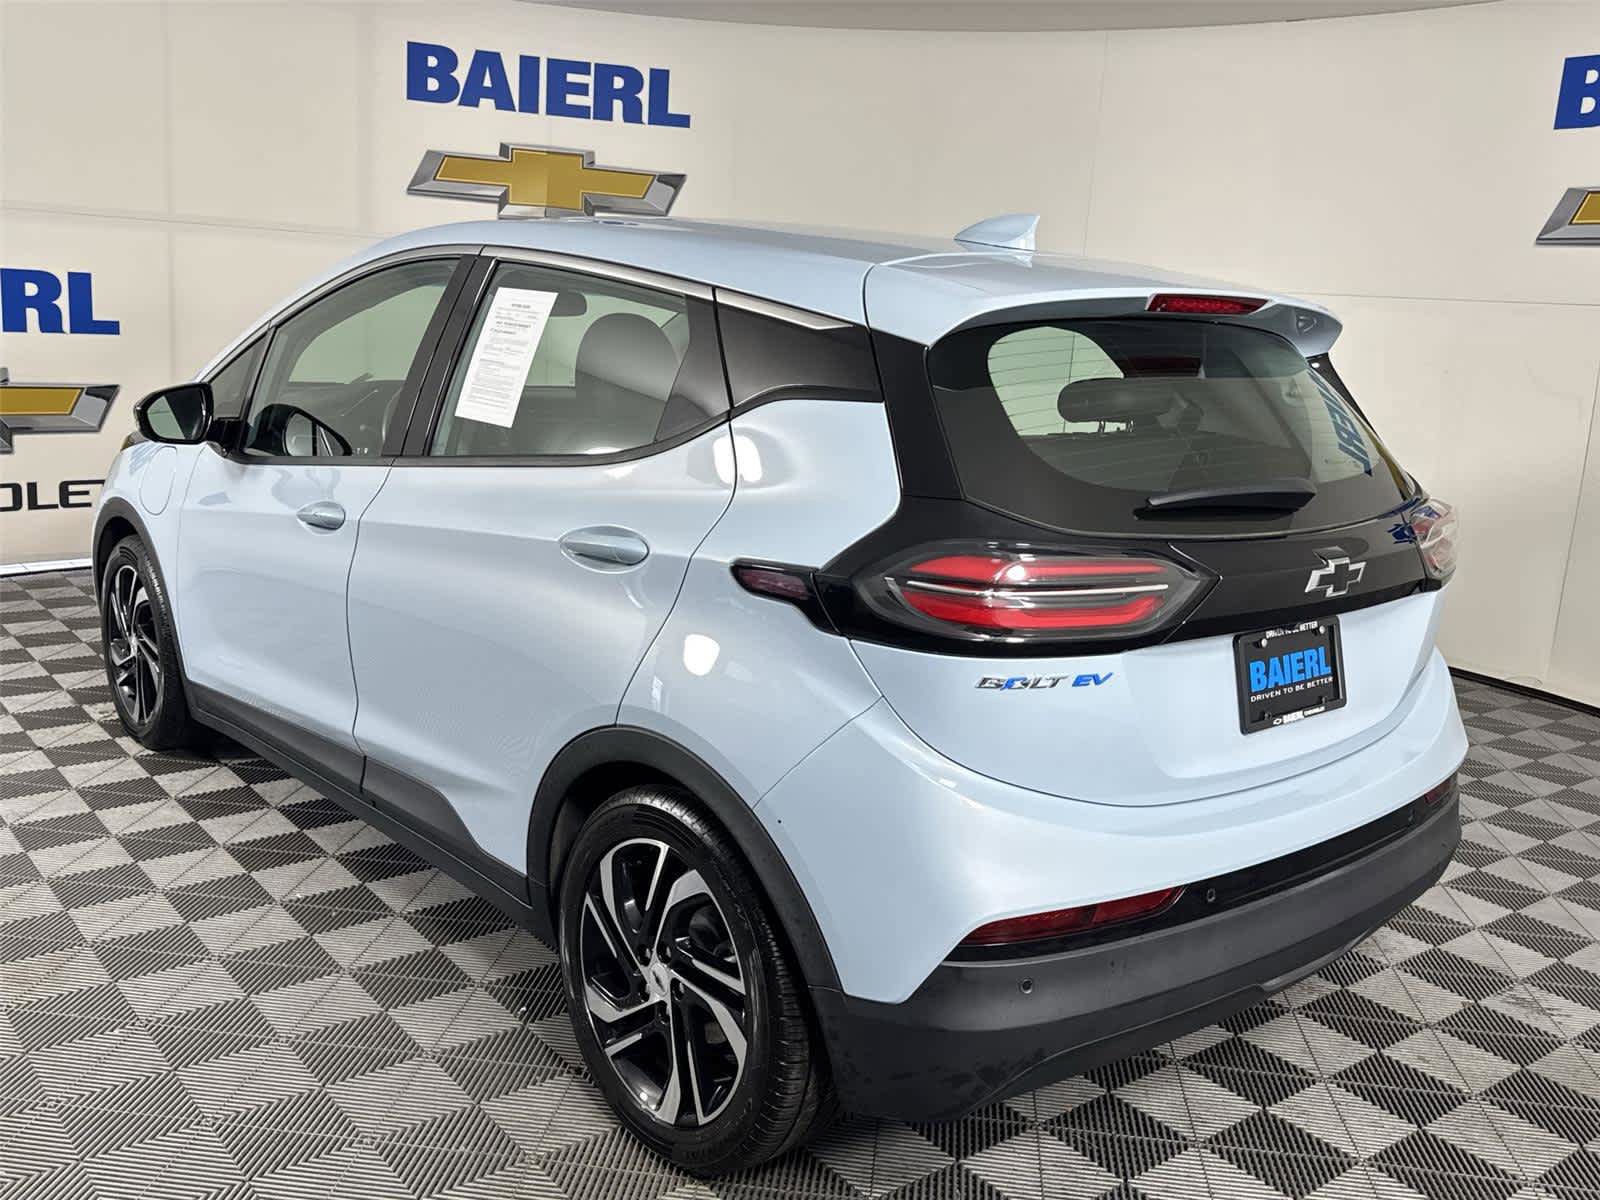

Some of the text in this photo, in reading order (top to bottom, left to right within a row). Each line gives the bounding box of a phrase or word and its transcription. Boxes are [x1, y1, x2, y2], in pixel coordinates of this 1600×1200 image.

[406, 40, 691, 129] BAIERL
[0, 479, 106, 512] OLE
[974, 671, 1114, 691] BOLT EV
[1249, 646, 1332, 693] BAIERL
[1250, 676, 1333, 703] DRIVEN TO BE BETTER
